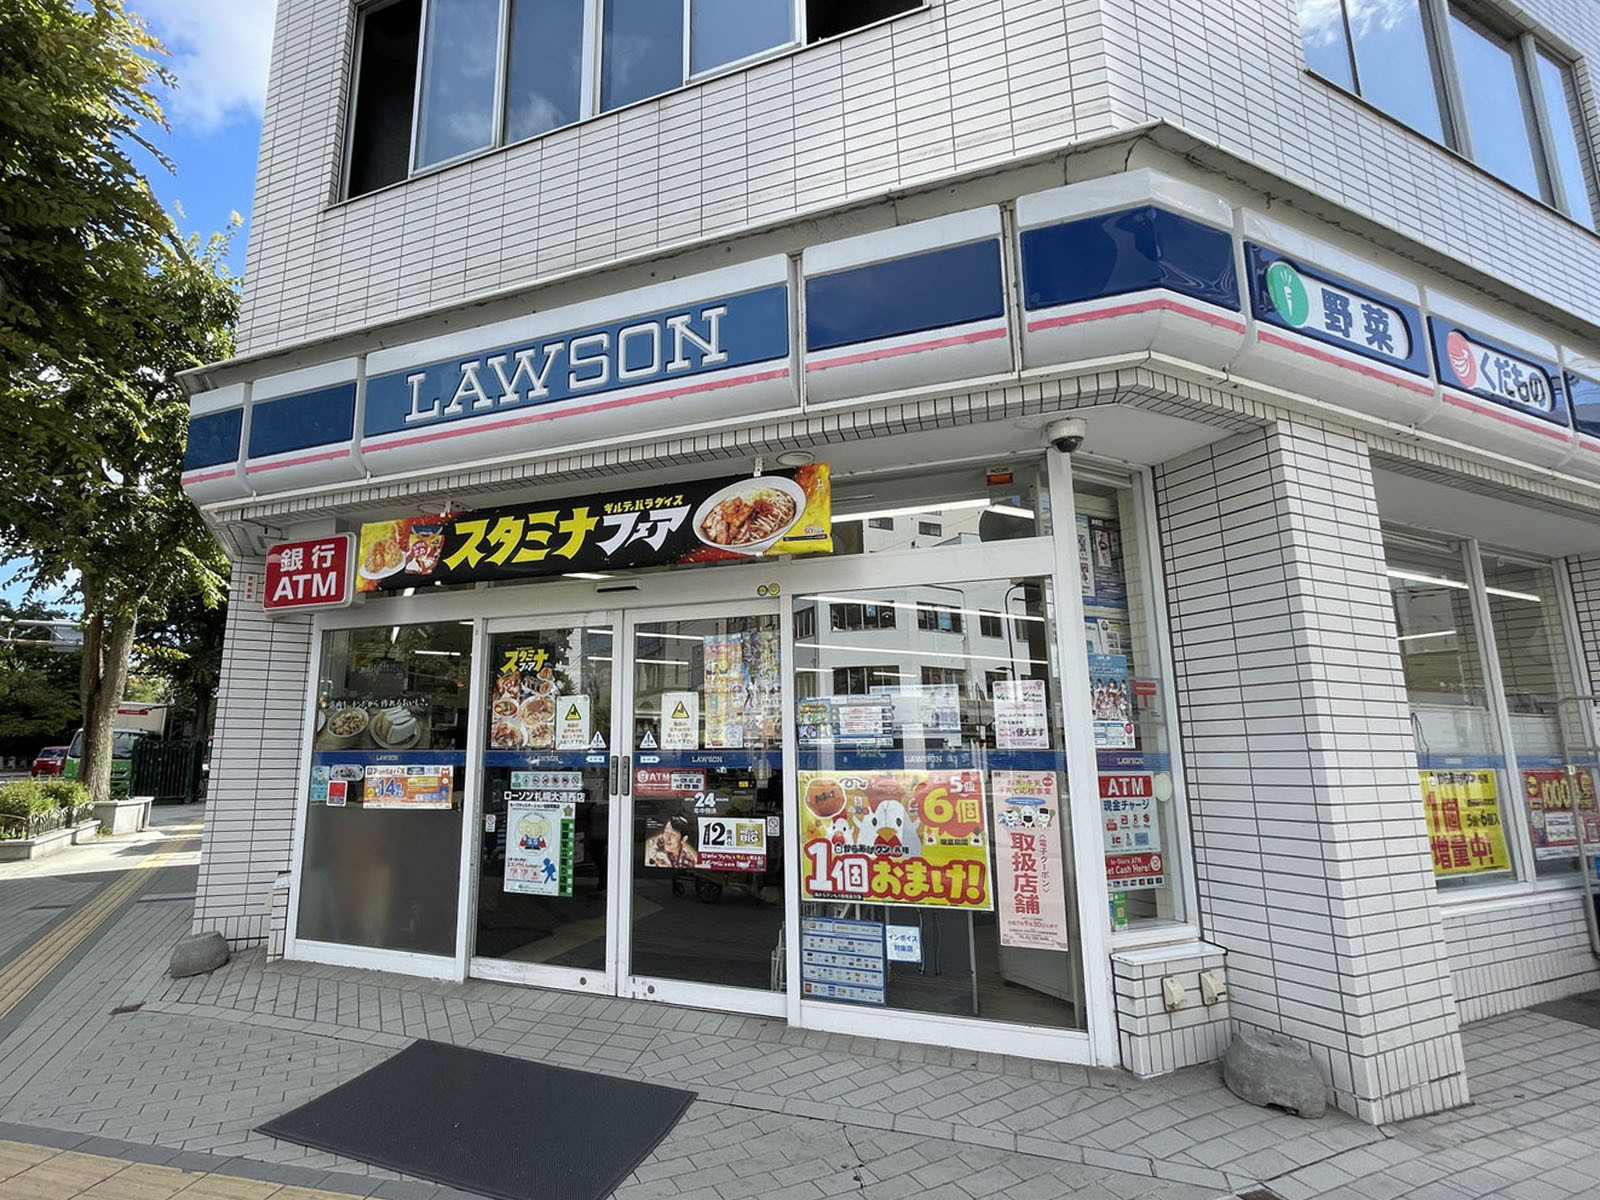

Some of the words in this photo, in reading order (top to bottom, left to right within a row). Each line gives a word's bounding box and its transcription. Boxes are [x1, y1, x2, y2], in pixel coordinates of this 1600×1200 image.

[1320, 287, 1395, 354] 野菜
[404, 305, 729, 425] LAWSON
[1479, 350, 1546, 405] くだもの
[603, 494, 684, 514] ギルティパラダイス
[442, 504, 692, 572] スタミナフェア
[280, 543, 336, 573] 銀行
[272, 571, 337, 602] ATM
[500, 649, 550, 673] スタミナ
[649, 772, 670, 782] ATM
[1107, 777, 1145, 797] ATM
[694, 791, 717, 808] 24
[923, 787, 980, 824] 6個
[1103, 799, 1150, 812] 現金チャージ
[843, 843, 891, 856] からあげクン
[1010, 832, 1041, 915] 取扱店舗
[1115, 865, 1132, 875] Cash
[888, 934, 918, 942] インボイス
